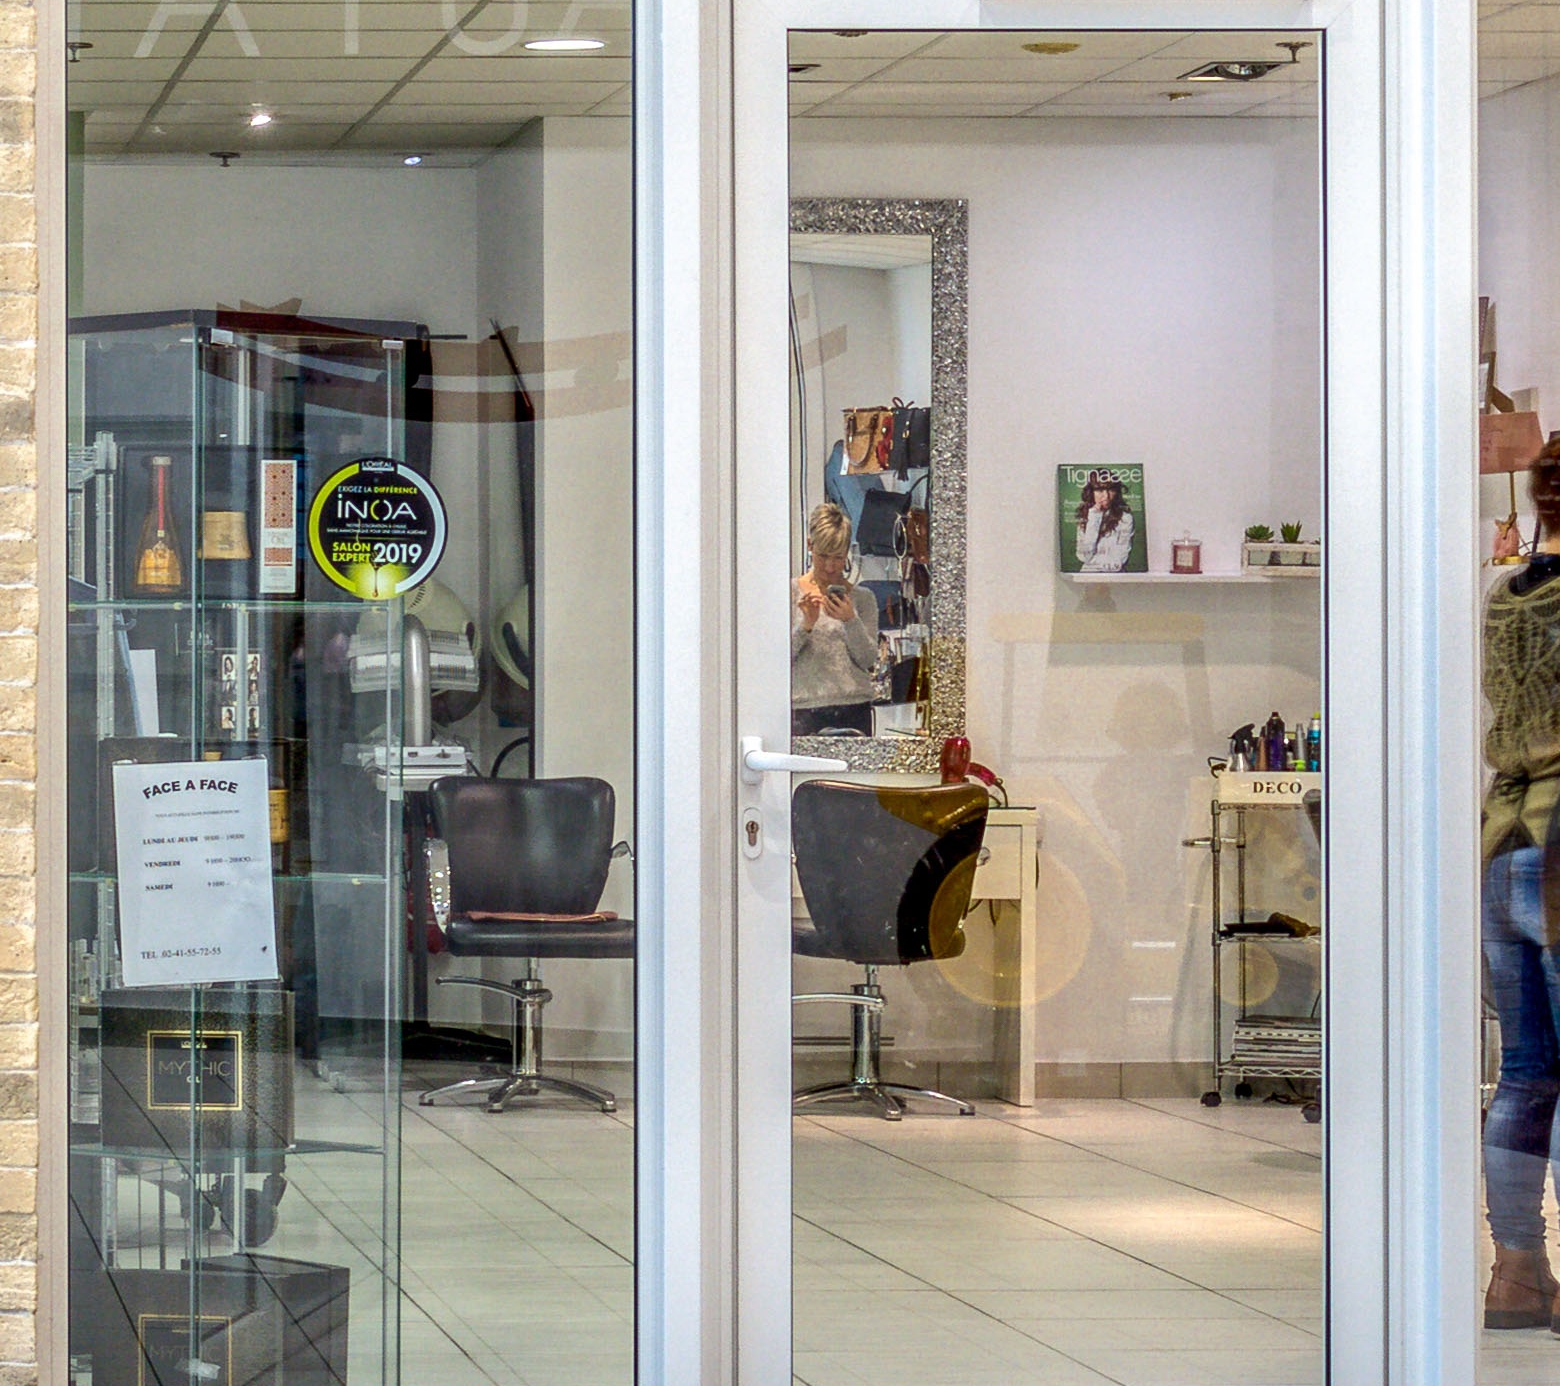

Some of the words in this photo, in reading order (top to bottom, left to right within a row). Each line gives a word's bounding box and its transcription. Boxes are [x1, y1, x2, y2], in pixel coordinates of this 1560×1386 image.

[1060, 465, 1142, 488] Tignasse
[338, 485, 362, 493] EXIGEZ
[332, 541, 371, 552] SALON
[373, 542, 423, 564] 2019
[332, 552, 371, 562] EXPERT
[142, 780, 181, 800] FACE
[185, 779, 196, 791] A
[199, 779, 239, 794] FACE
[1253, 781, 1303, 794] DECO
